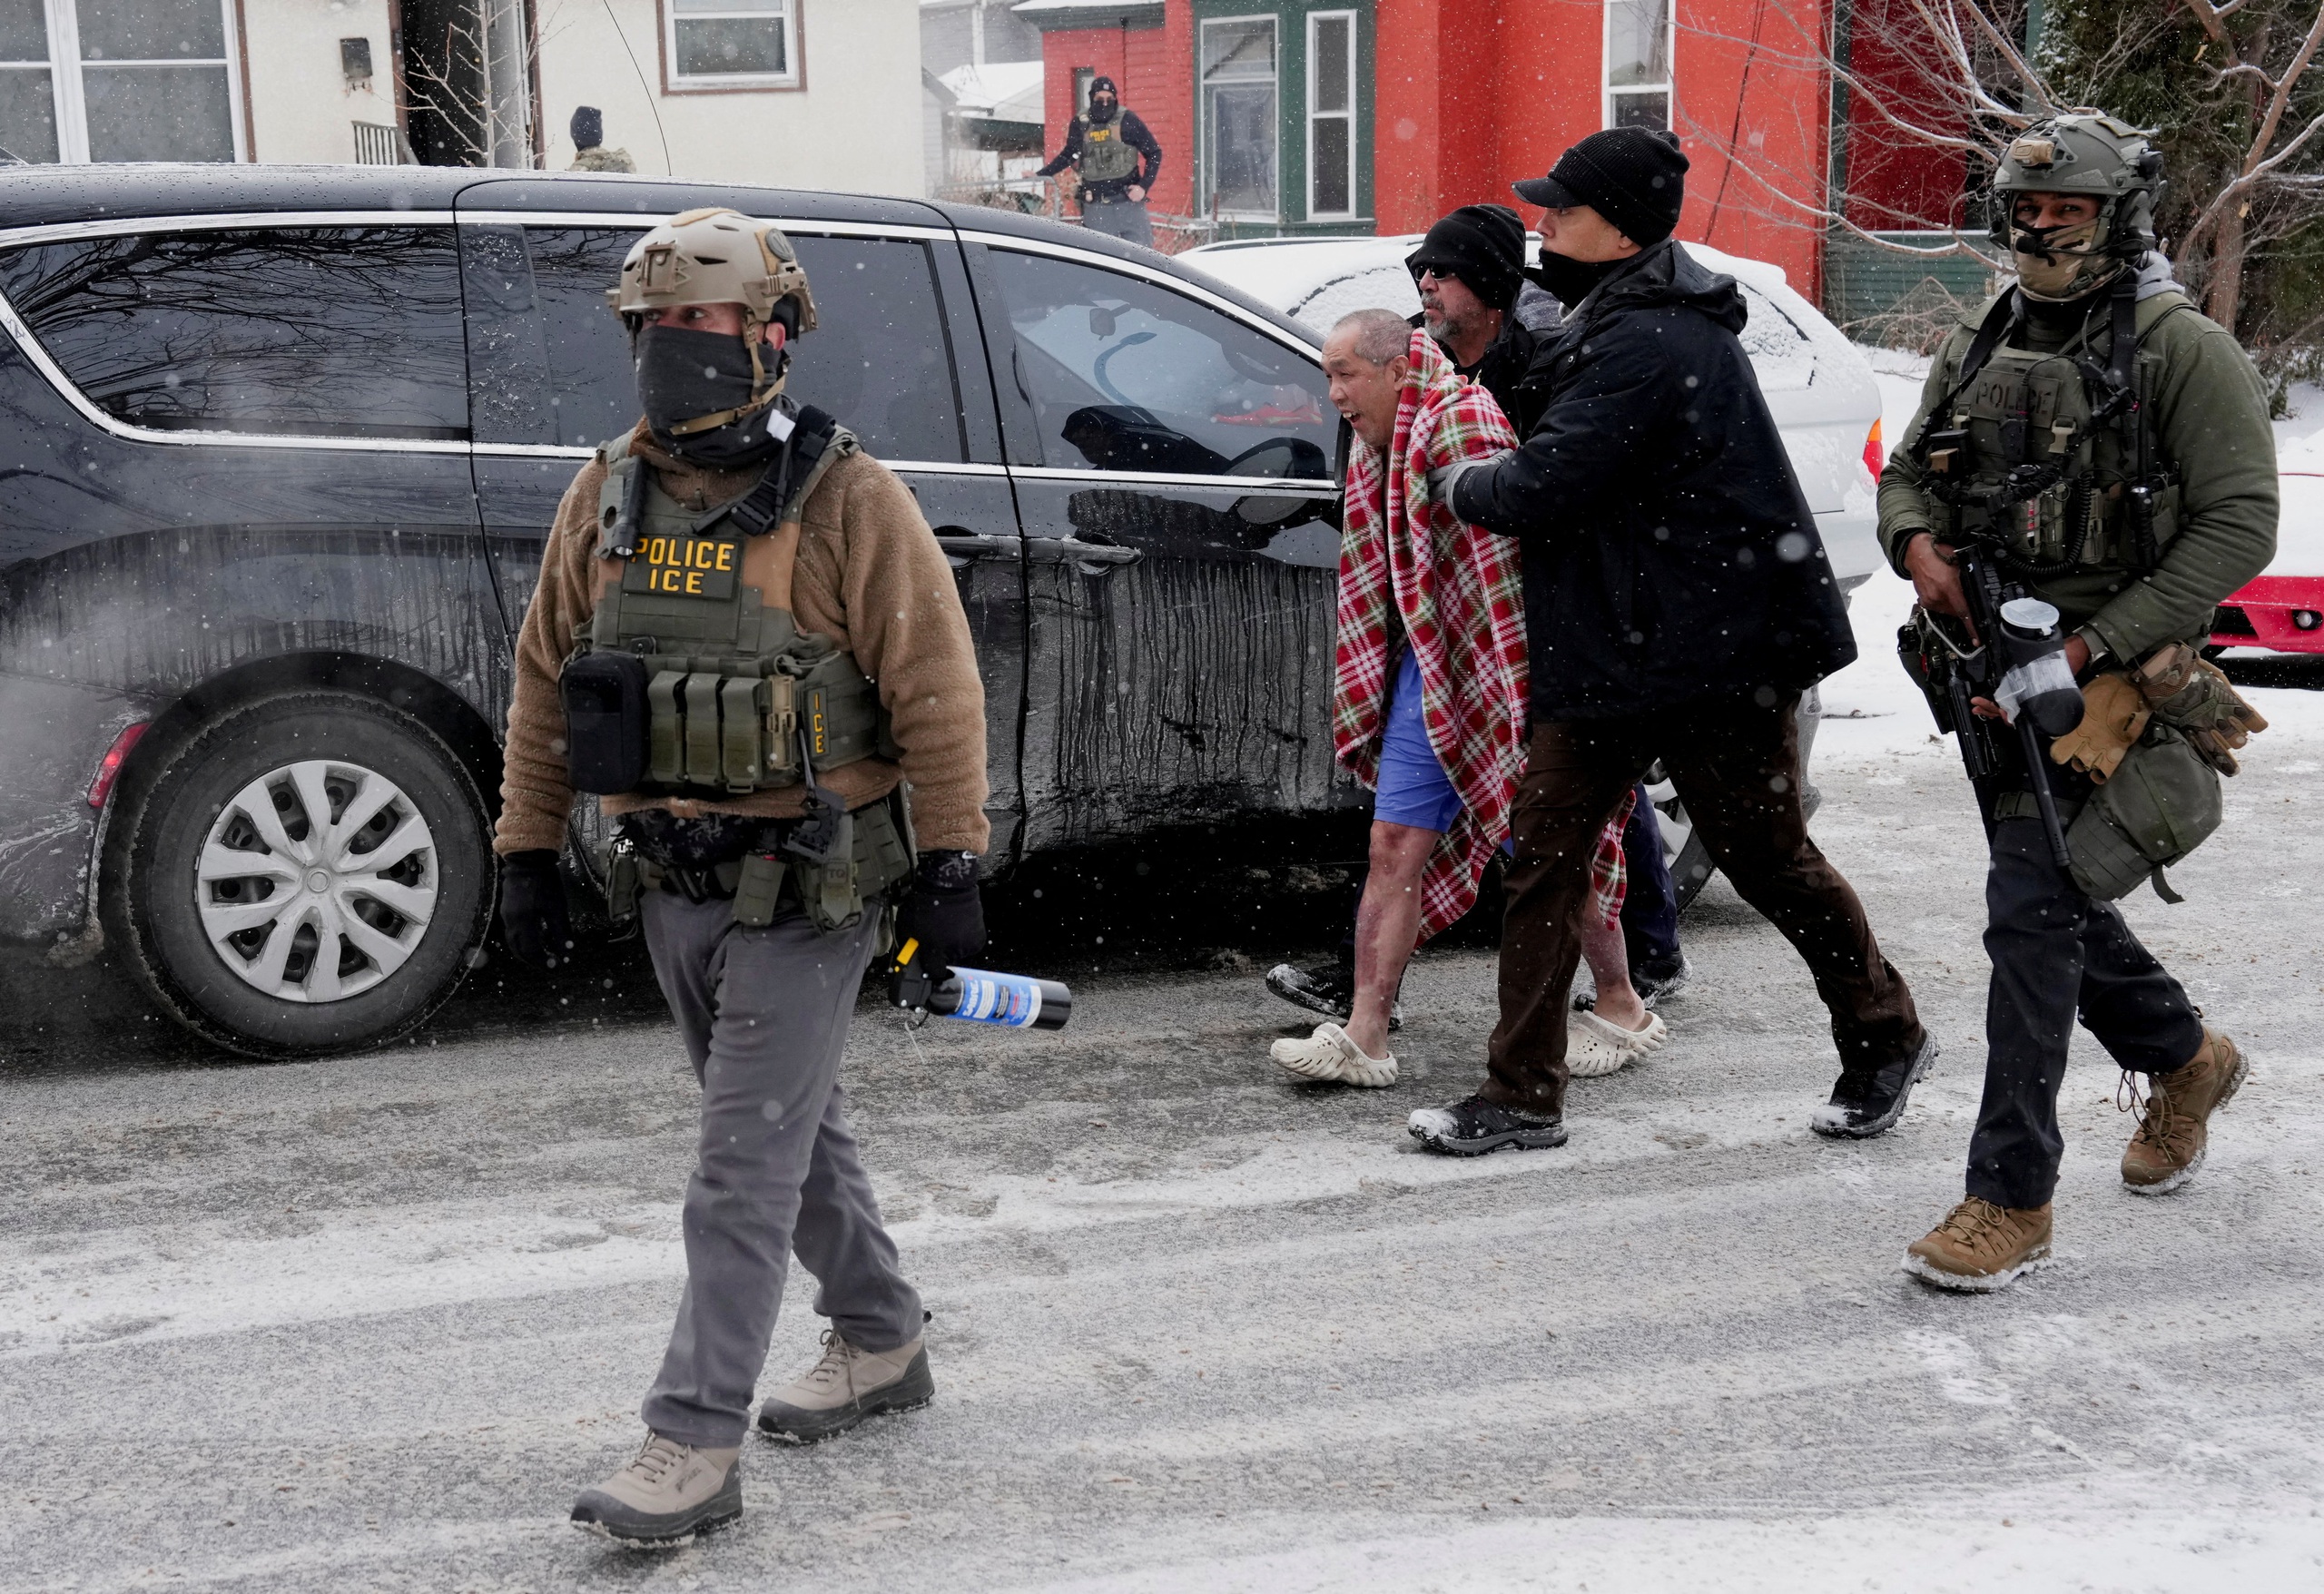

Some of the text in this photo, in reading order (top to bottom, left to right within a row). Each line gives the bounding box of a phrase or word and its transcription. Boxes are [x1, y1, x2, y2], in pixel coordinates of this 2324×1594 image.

[1089, 129, 1110, 138] POLICE
[631, 537, 735, 571] POLICE
[649, 568, 705, 595] ICE
[813, 693, 825, 754] ICE
[827, 869, 845, 879] TQ
